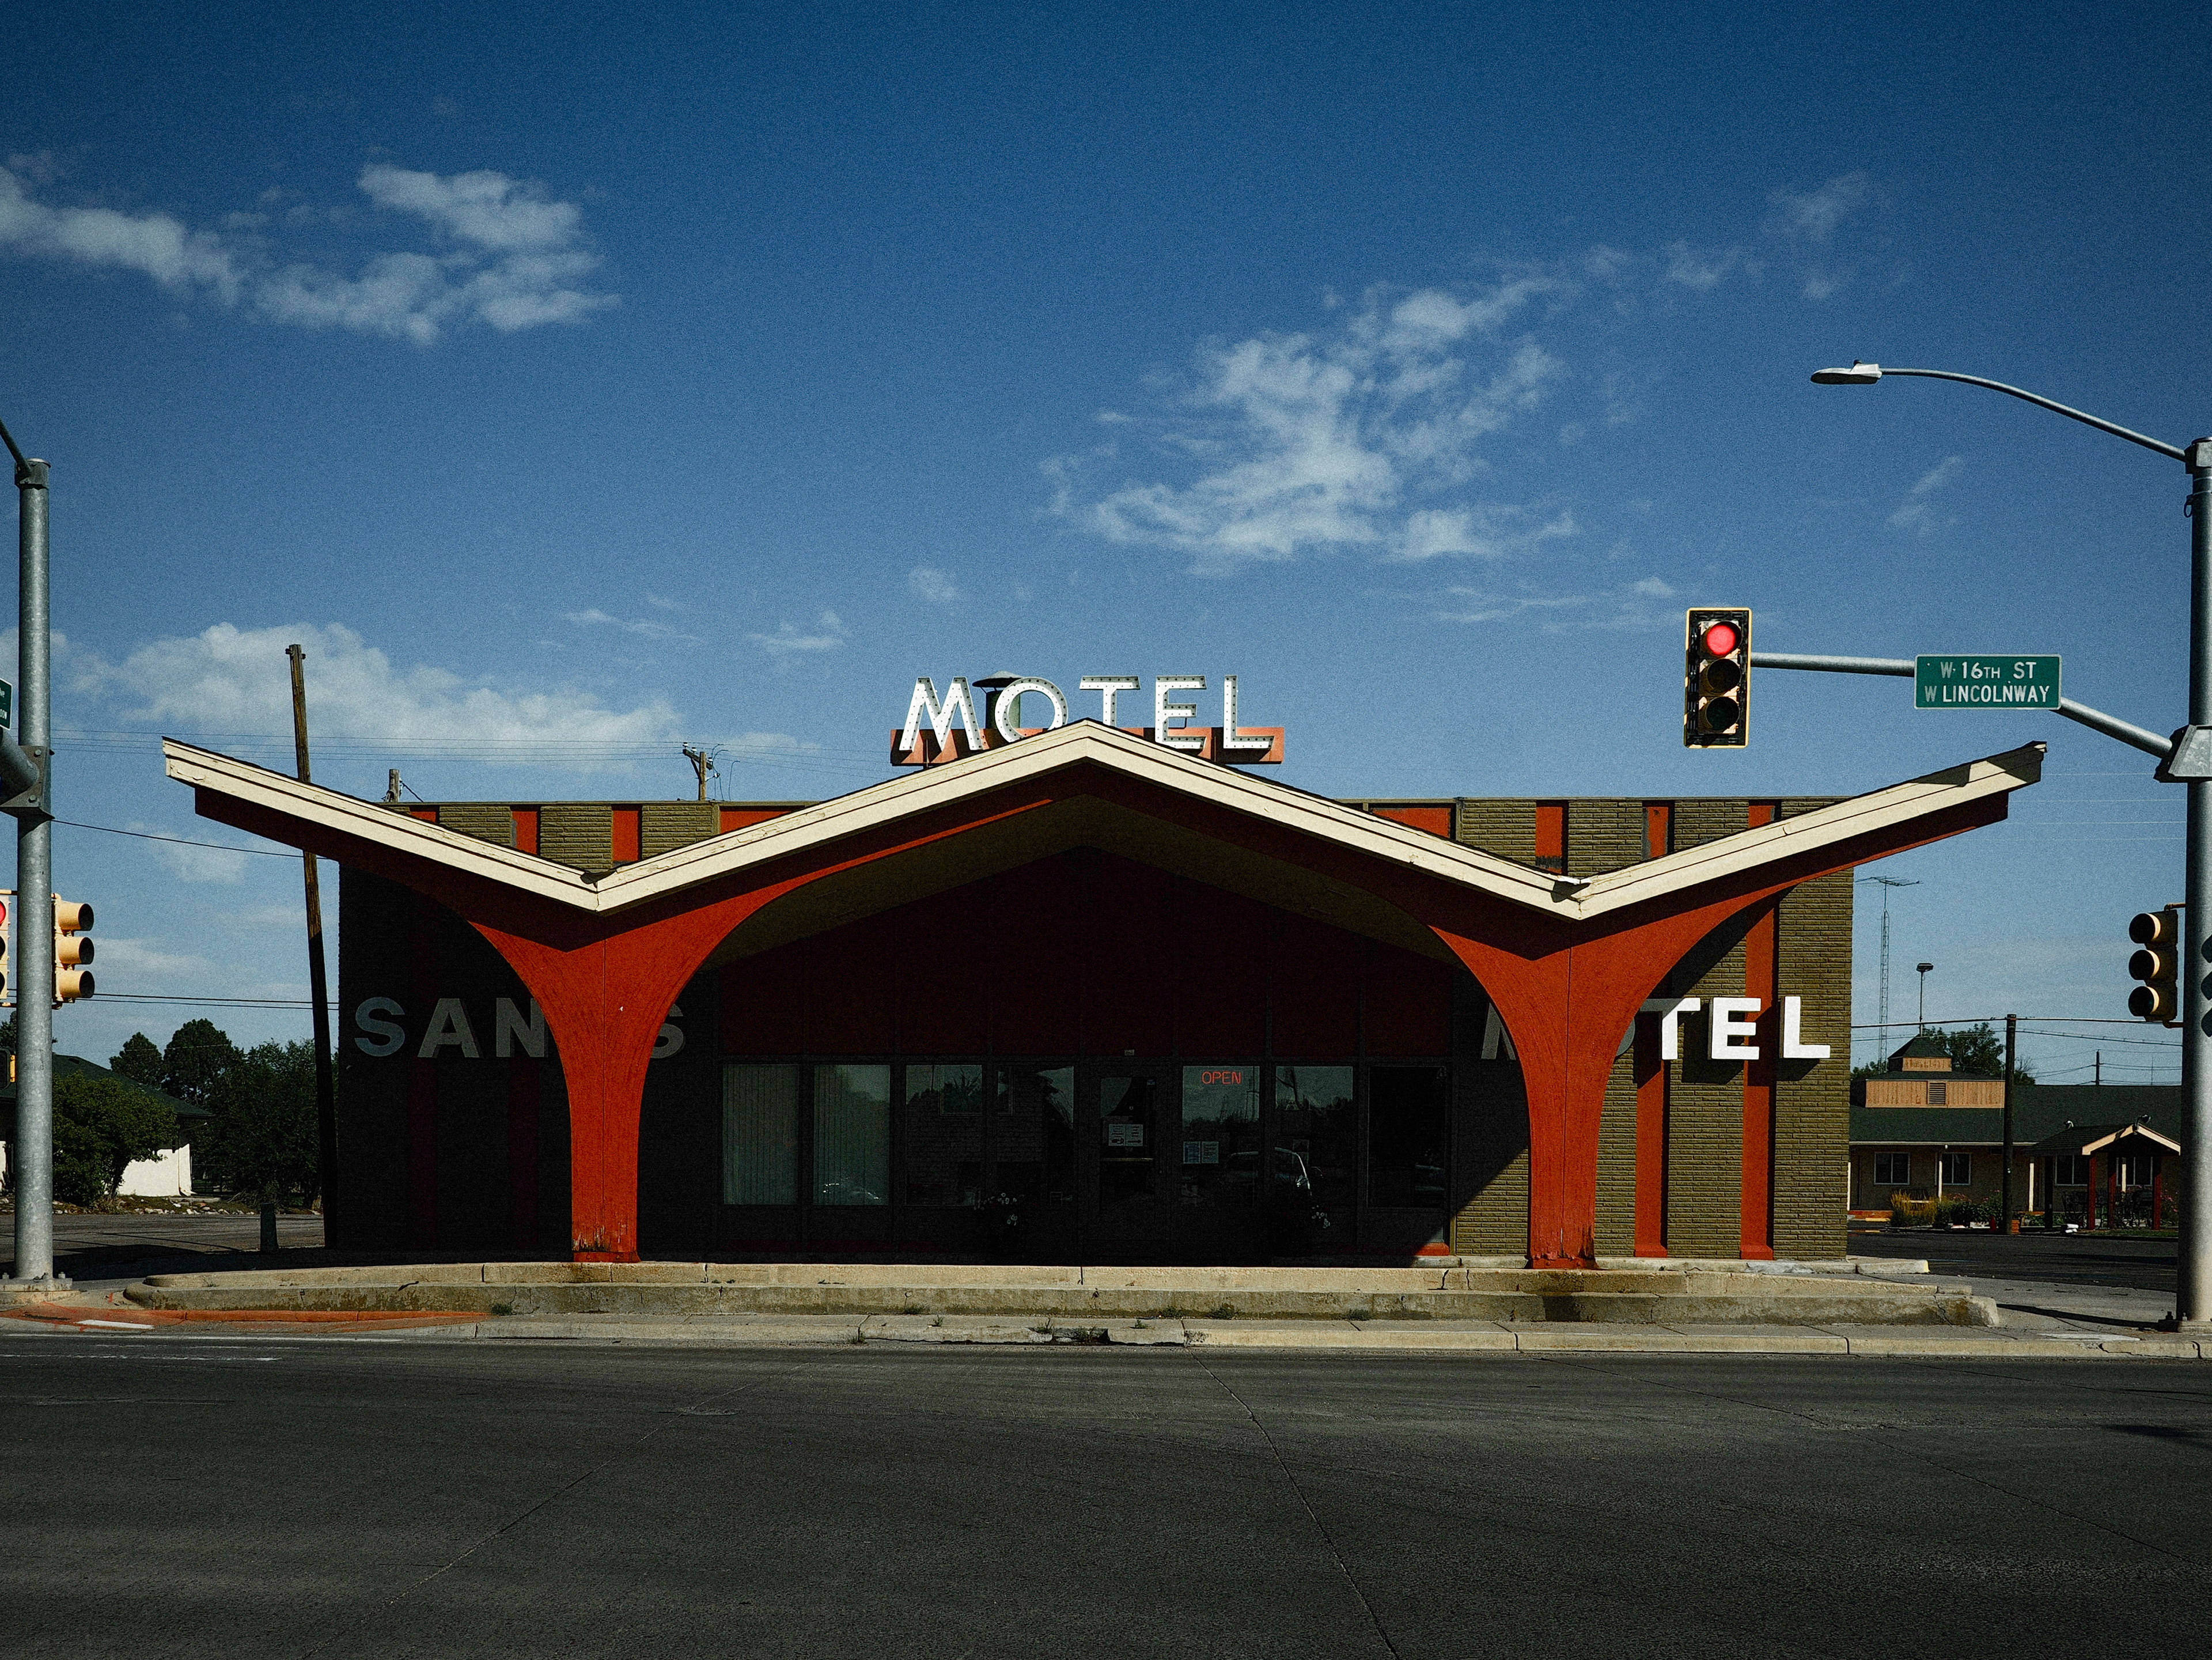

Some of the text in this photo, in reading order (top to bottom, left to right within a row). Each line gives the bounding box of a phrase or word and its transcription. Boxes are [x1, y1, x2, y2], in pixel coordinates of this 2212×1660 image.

[1940, 661, 2036, 679] W 16TH ST
[899, 675, 1275, 751] MOTEL
[1925, 685, 2050, 702] W LINCOLNWAY
[354, 997, 685, 1059] SAN
[1481, 996, 1831, 1060] TEL
[1202, 1071, 1242, 1084] OPEN
